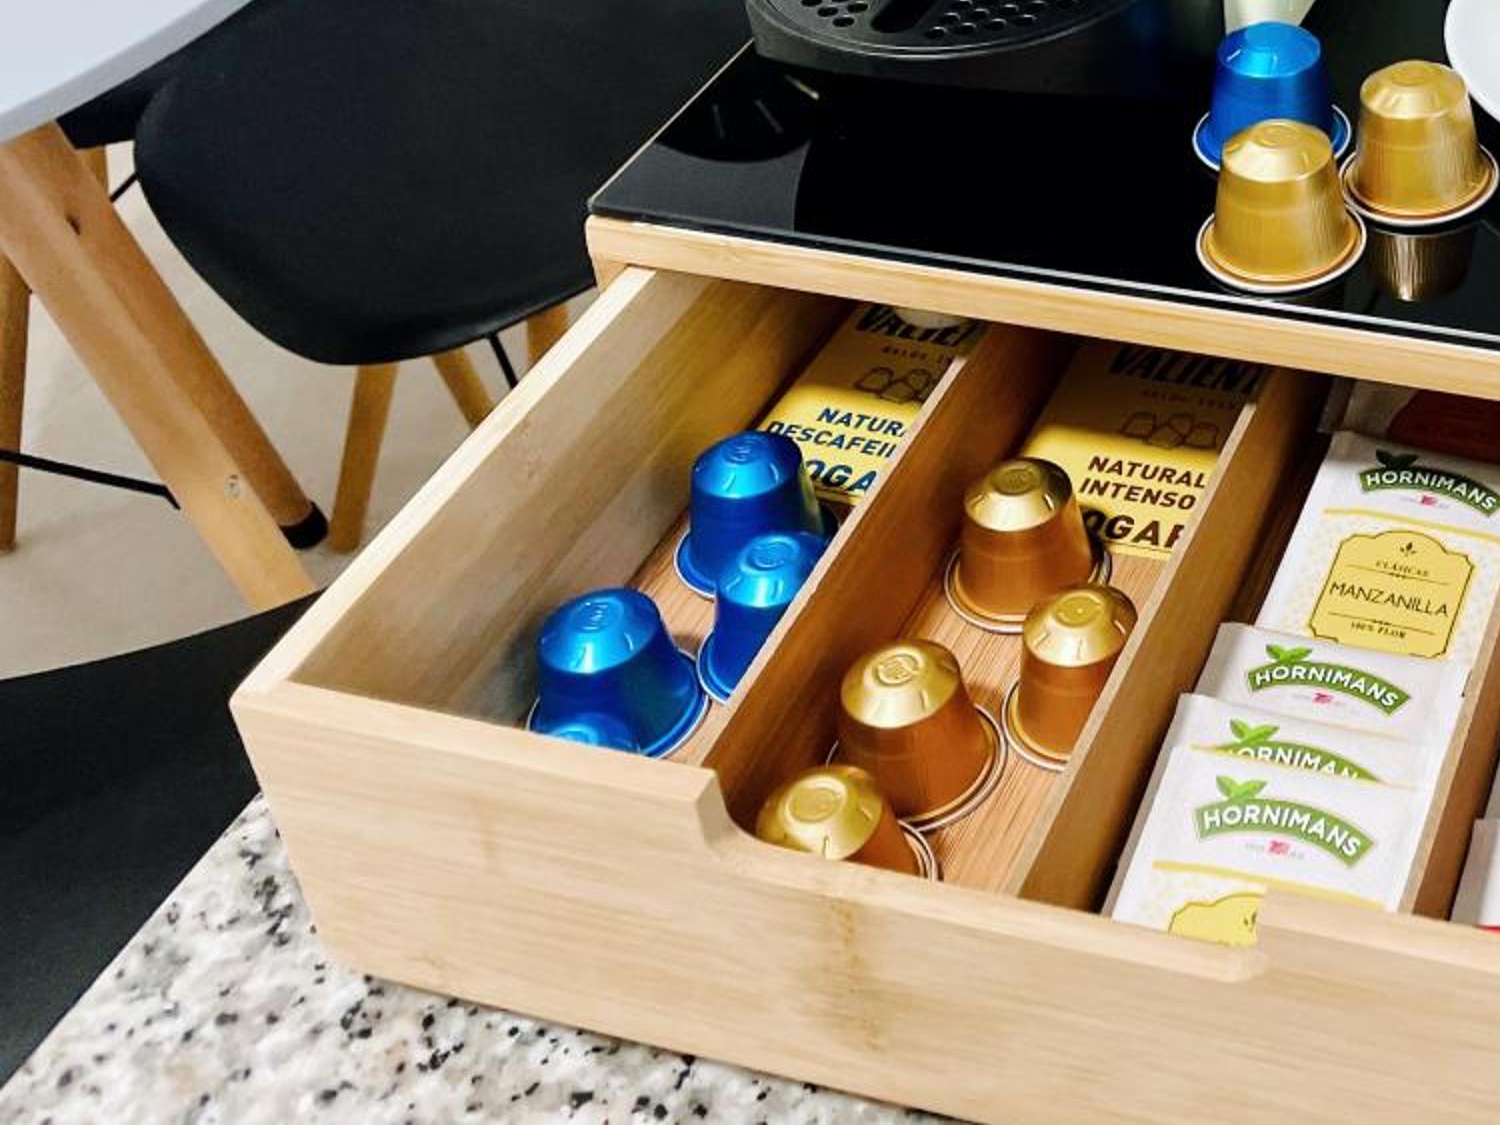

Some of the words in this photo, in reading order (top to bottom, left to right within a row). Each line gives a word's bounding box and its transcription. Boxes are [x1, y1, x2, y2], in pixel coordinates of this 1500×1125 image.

[816, 408, 906, 437] NATUR
[1088, 456, 1207, 489] NATURAL
[1366, 470, 1497, 511] HORNIMANS
[1079, 478, 1197, 510] INTENSO
[1329, 580, 1449, 618] MANZANILLA
[1255, 665, 1398, 707] HORNIMANS
[1203, 804, 1361, 857] HORNIMANS
